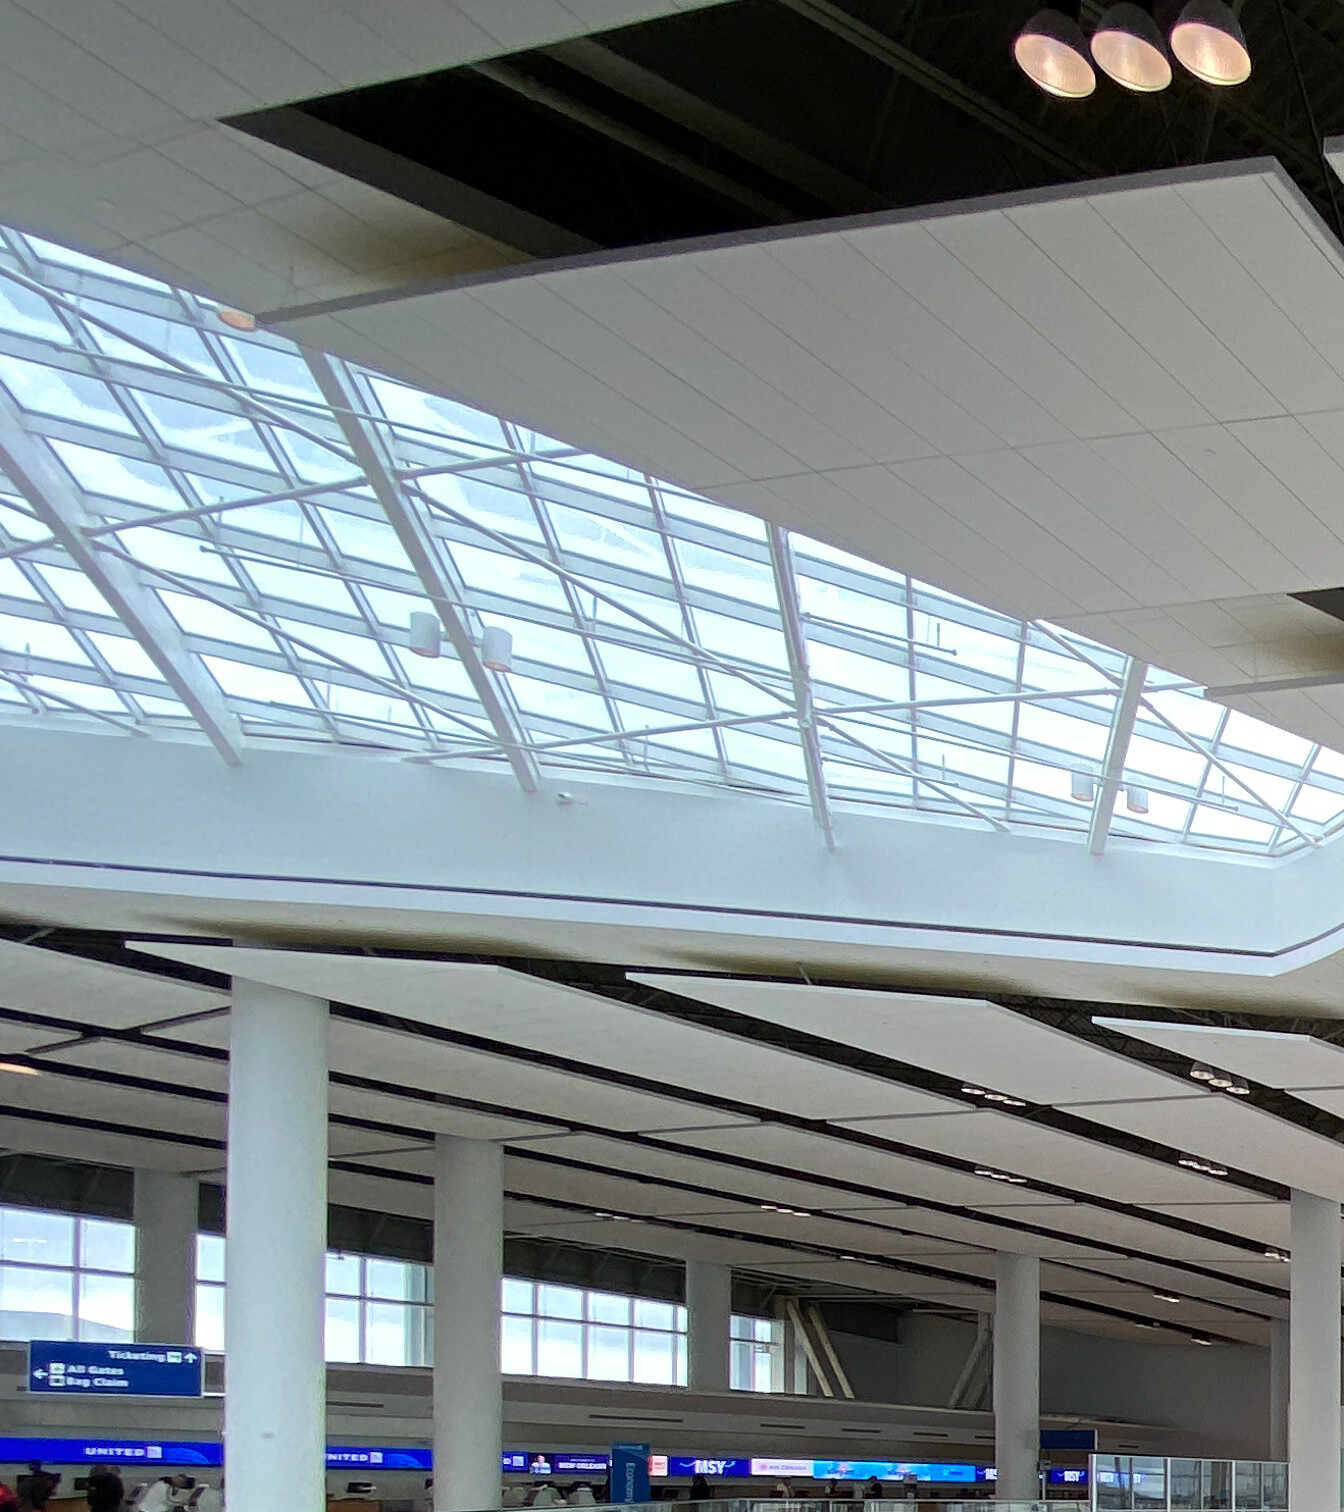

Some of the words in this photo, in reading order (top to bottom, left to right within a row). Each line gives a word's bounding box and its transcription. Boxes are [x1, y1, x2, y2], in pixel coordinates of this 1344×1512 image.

[108, 1351, 166, 1363] Ticketing
[66, 1365, 86, 1374] All
[88, 1366, 124, 1375] Gates
[66, 1377, 91, 1388] Bag
[94, 1378, 129, 1387] Claim
[85, 1447, 145, 1457] UNITED
[326, 1453, 369, 1462] NITED
[695, 1459, 727, 1474] MSY
